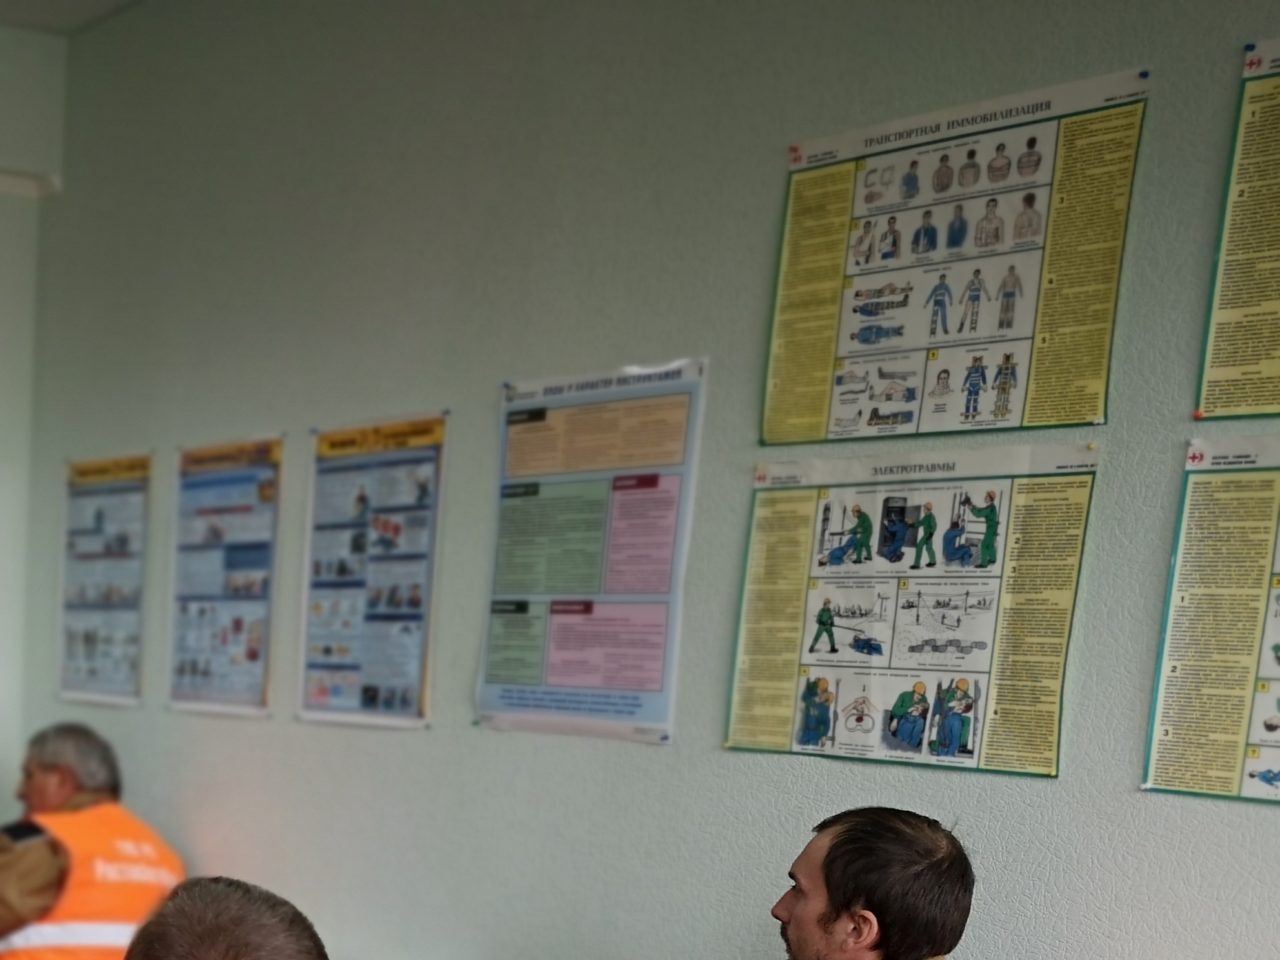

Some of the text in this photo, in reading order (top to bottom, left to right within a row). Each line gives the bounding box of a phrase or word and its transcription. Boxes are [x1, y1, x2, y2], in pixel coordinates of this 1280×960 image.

[864, 123, 941, 148] ТРАНСПОРТНАЯ
[946, 100, 1052, 130] ИММОБИЛИЗАЦИЯ
[871, 462, 956, 477] ЭЛЕКТРОТРАВМЫ
